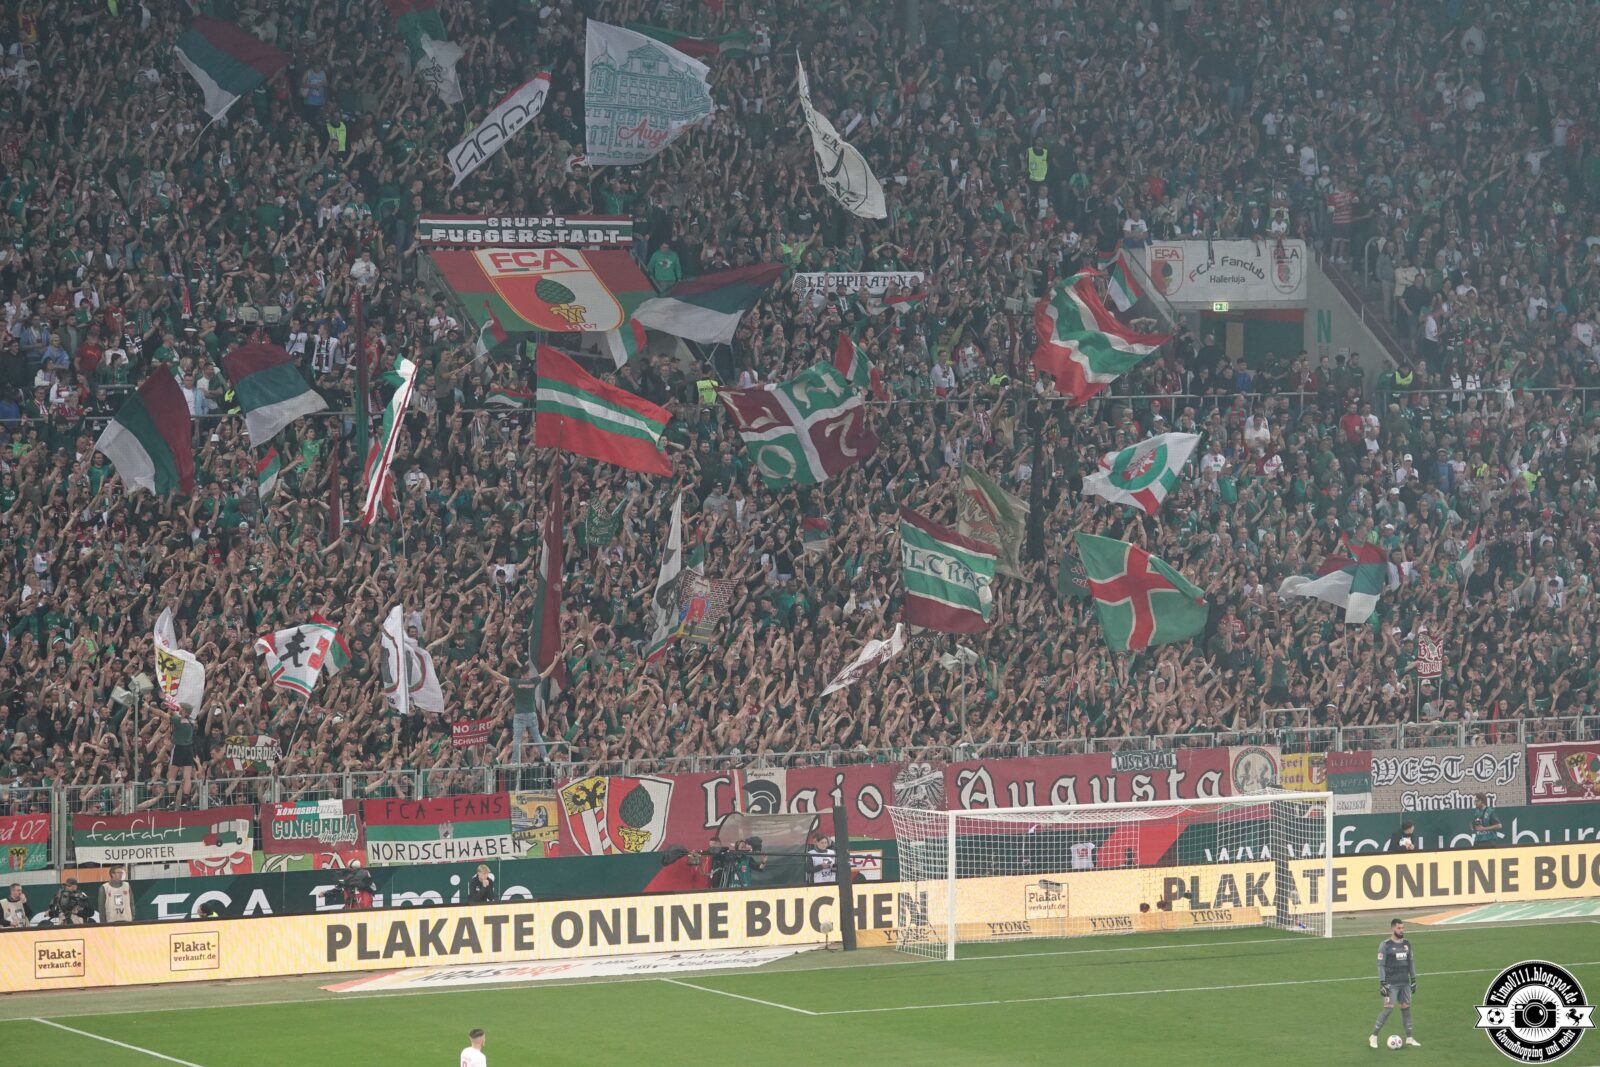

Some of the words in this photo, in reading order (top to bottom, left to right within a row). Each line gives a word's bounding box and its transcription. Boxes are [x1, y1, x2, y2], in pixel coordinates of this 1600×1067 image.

[487, 217, 566, 228] GRUPPE
[431, 229, 620, 244] FUGGERSTADT
[488, 249, 579, 270] FCA
[1154, 249, 1180, 259] FCA
[1220, 256, 1265, 280] Fanclub
[1316, 309, 1332, 344] N
[1372, 750, 1522, 787] WEST-OF
[385, 801, 426, 819] FCA
[453, 797, 503, 816] FANS
[20, 819, 47, 840] 07
[86, 817, 187, 843] fanfahrt
[272, 814, 358, 840] CONCORDIA
[104, 846, 175, 861] SUPPORTER
[371, 838, 522, 861] NORDSCHWABEN
[1164, 867, 1348, 912] PLAKATE
[1362, 857, 1519, 901] ONLINE
[1089, 916, 1133, 929] YTONG
[1190, 910, 1233, 922] YTONG
[326, 914, 535, 962] PLAKATE
[550, 903, 729, 949] ONLINE
[987, 921, 1031, 933] YTONG
[38, 949, 82, 961] Plakat-
[173, 941, 217, 953] Plakat-
[38, 961, 82, 970] verkauft.de
[173, 952, 217, 962] verkauft.de
